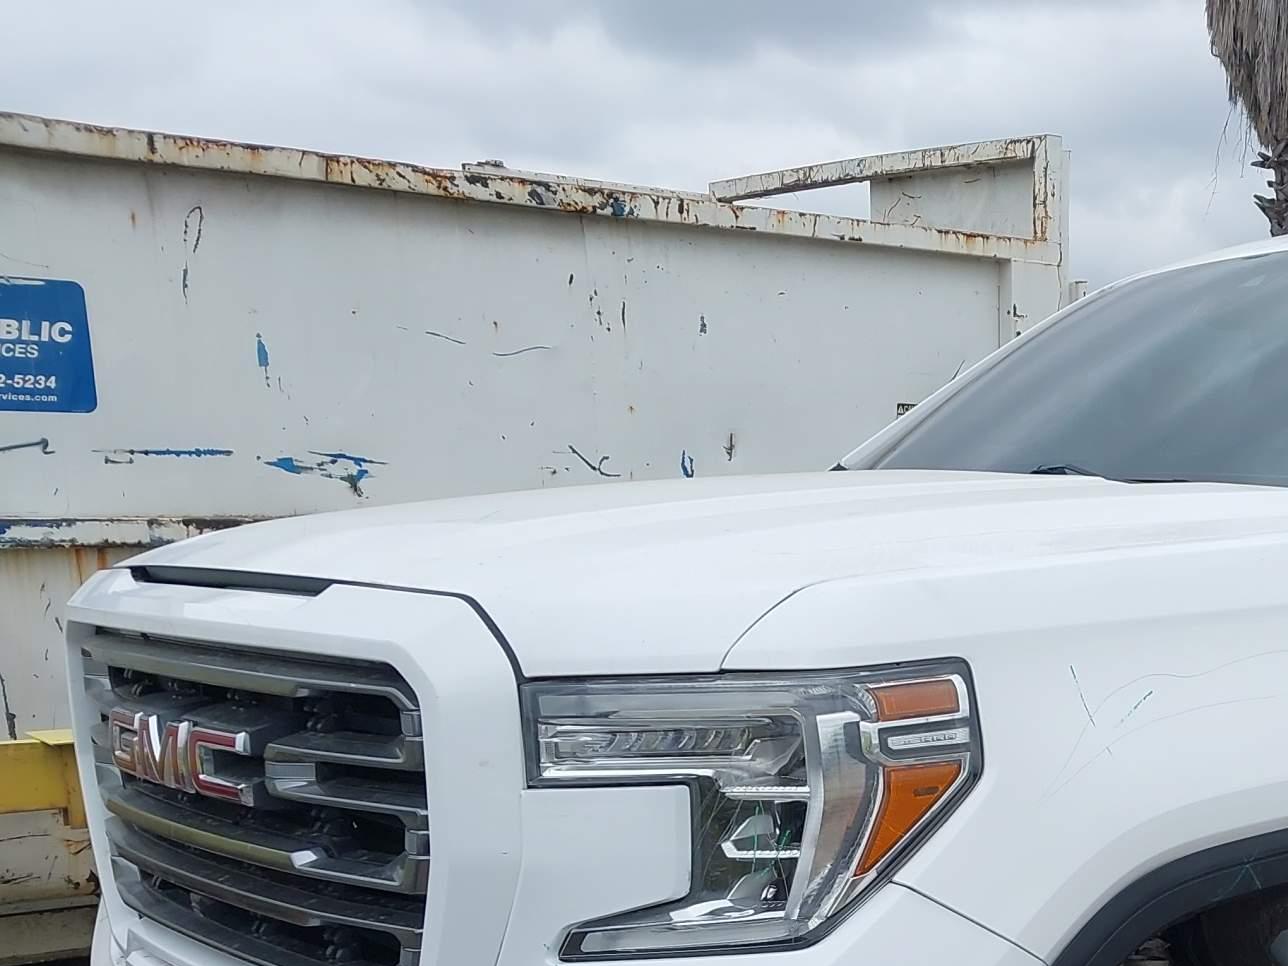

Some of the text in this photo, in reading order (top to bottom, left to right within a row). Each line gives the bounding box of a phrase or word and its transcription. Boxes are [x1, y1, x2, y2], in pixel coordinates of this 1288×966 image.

[0, 318, 73, 343] BLIC
[0, 343, 39, 358] CES
[108, 706, 254, 807] GMC
